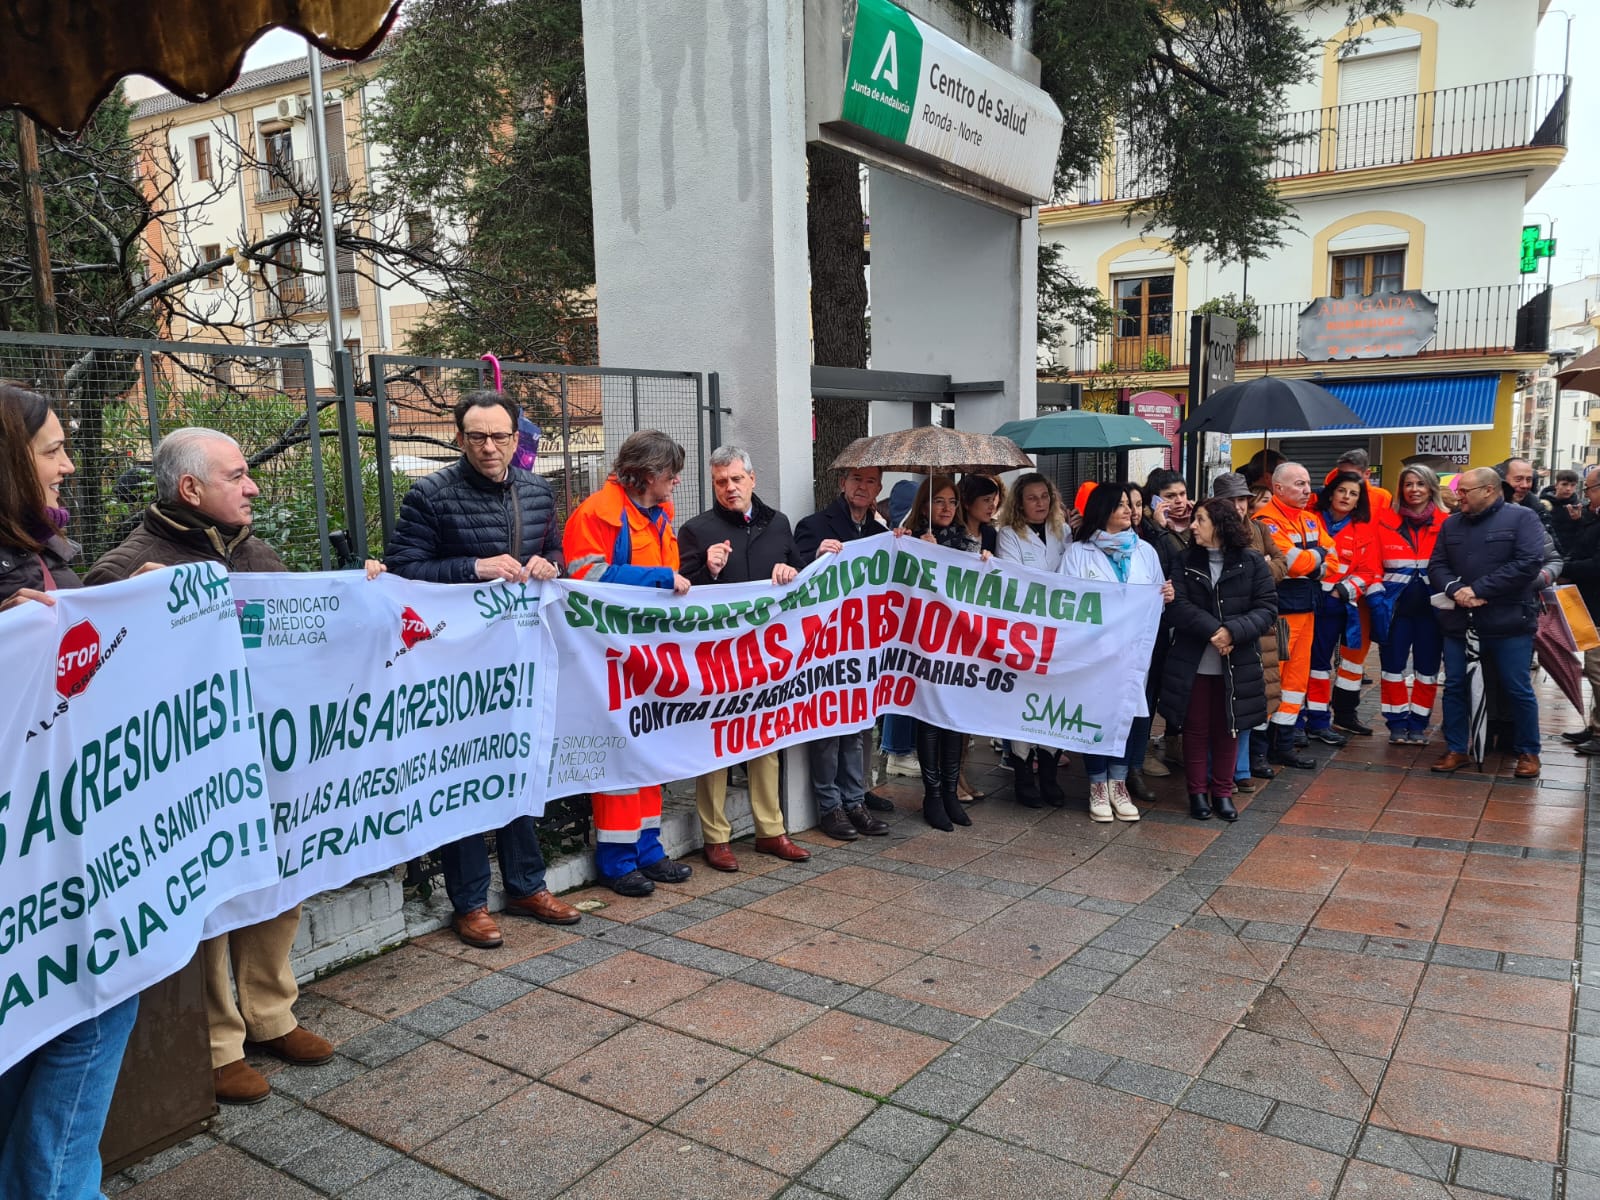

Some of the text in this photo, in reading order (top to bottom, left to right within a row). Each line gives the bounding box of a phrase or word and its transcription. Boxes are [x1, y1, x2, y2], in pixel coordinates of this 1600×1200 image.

[851, 79, 871, 97] Junta
[871, 88, 880, 101] de
[930, 63, 1029, 136] Centro de Salud
[922, 104, 952, 133] Ronda
[958, 121, 983, 147] Norte
[1317, 296, 1416, 316] ABOGADA
[1418, 434, 1468, 452] SE ALQUILA
[267, 595, 340, 614] SINDICATO
[565, 590, 775, 634] SINDICATO
[891, 549, 938, 593] DE
[945, 565, 1103, 625] MÁLAGA
[268, 629, 328, 647] MÁLAGA
[269, 613, 325, 631] MÉDICO
[57, 642, 98, 677] STOP
[385, 660, 393, 669] A
[605, 642, 690, 711] ¡NO
[694, 622, 794, 697] MAS
[309, 683, 371, 764] MÁS
[368, 662, 535, 742] AGRESIONES!!
[629, 699, 706, 738] CONTRA
[709, 694, 754, 720] LAS
[751, 657, 862, 712] AGRESIONES
[867, 656, 878, 682] A
[1022, 692, 1102, 733] SMA
[25, 730, 38, 742] A
[710, 687, 867, 759] TOLERANCIA
[559, 750, 606, 765] MÉDICO
[562, 735, 627, 749] SINDICATO
[301, 781, 333, 824] LAS
[334, 752, 426, 809] AGRESIONES
[428, 749, 437, 778] A
[440, 732, 531, 773] SANITARIOS
[557, 766, 605, 785] MÁLAGA
[429, 773, 527, 817] CERO!!
[140, 824, 157, 867] A
